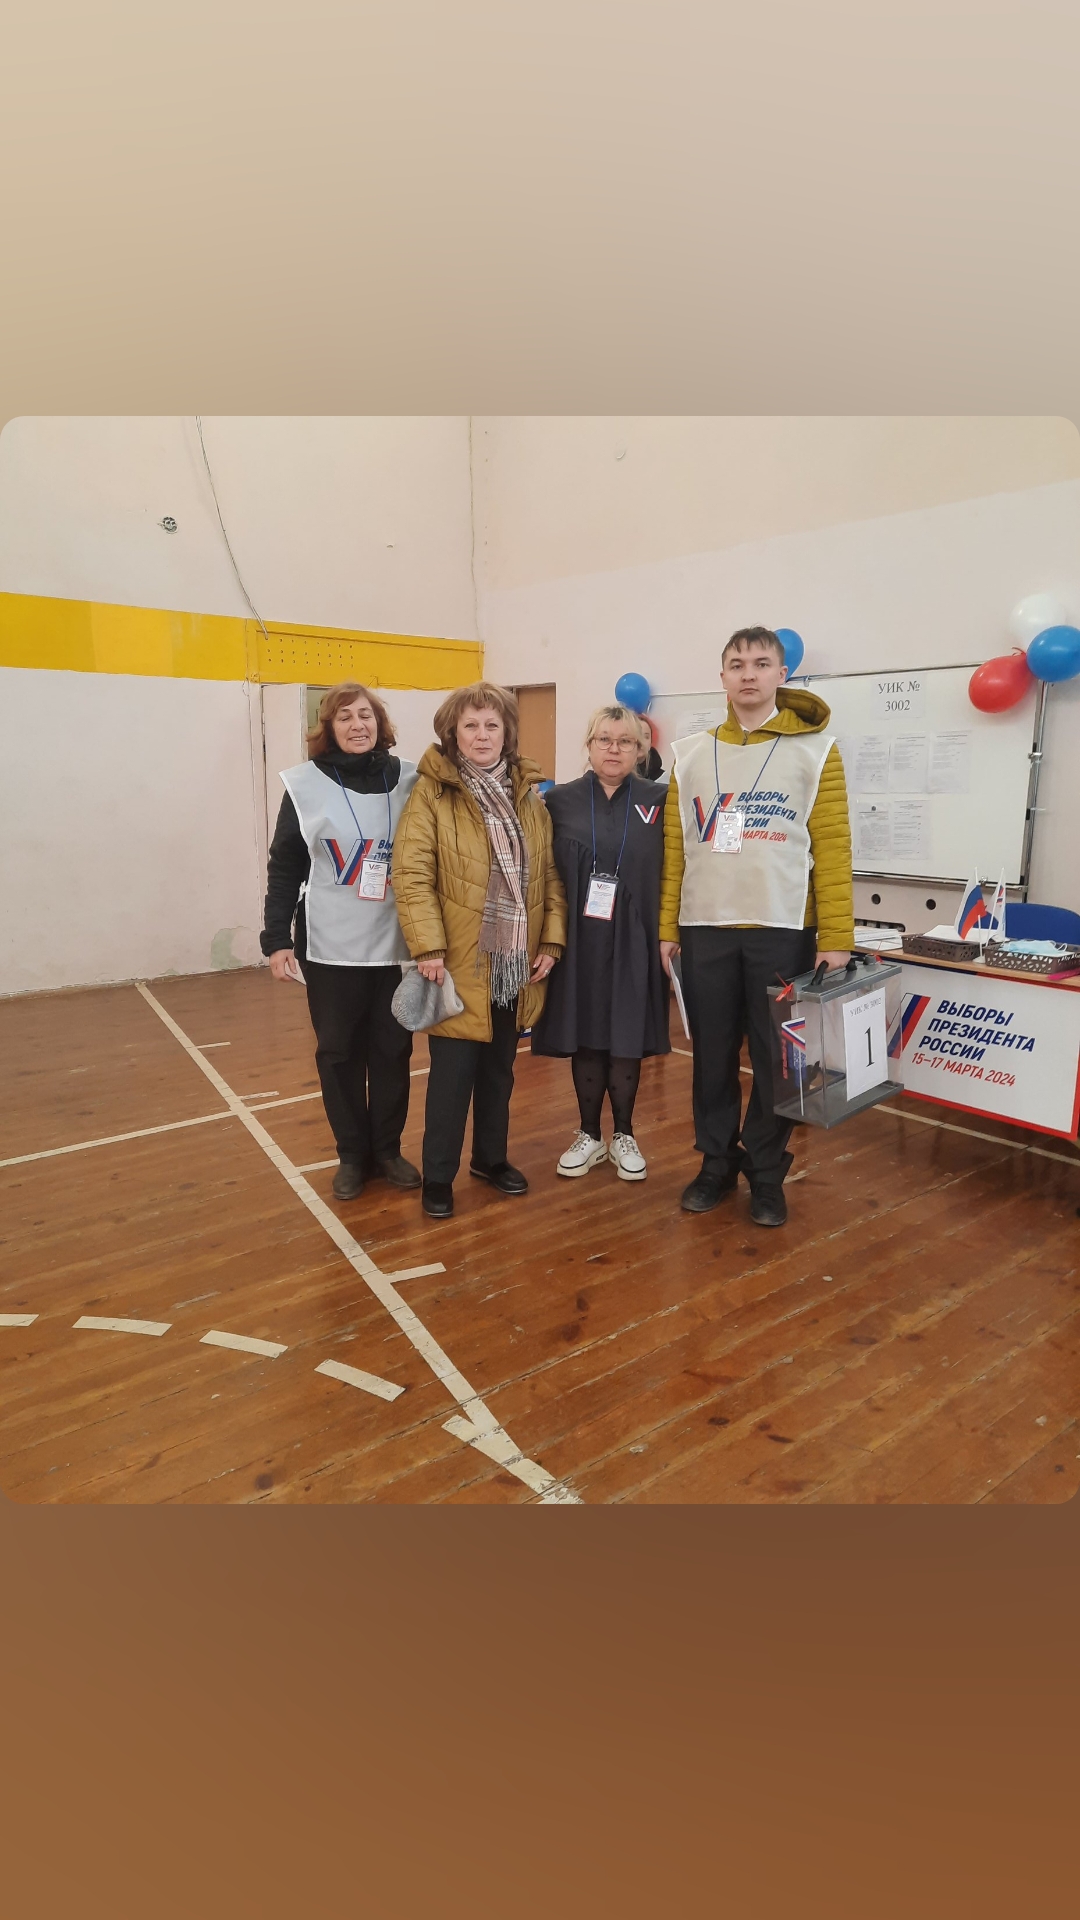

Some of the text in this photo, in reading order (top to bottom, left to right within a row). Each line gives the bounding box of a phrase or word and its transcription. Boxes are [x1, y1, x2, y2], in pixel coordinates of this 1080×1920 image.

[878, 680, 920, 694] УИК №
[885, 699, 910, 711] 3002
[737, 791, 790, 804] ВЫБОРЫ
[735, 804, 797, 821] ЕЗИДЕНТА
[769, 831, 788, 842] 2024
[937, 1000, 1014, 1026] ВЫБОРЫ
[927, 1018, 1036, 1052] ПРЕЗИДЕНТА
[864, 1026, 875, 1067] 1
[918, 1035, 986, 1061] РОССИИ
[943, 1060, 984, 1079] МАРТА
[984, 1069, 1016, 1086] 2024
